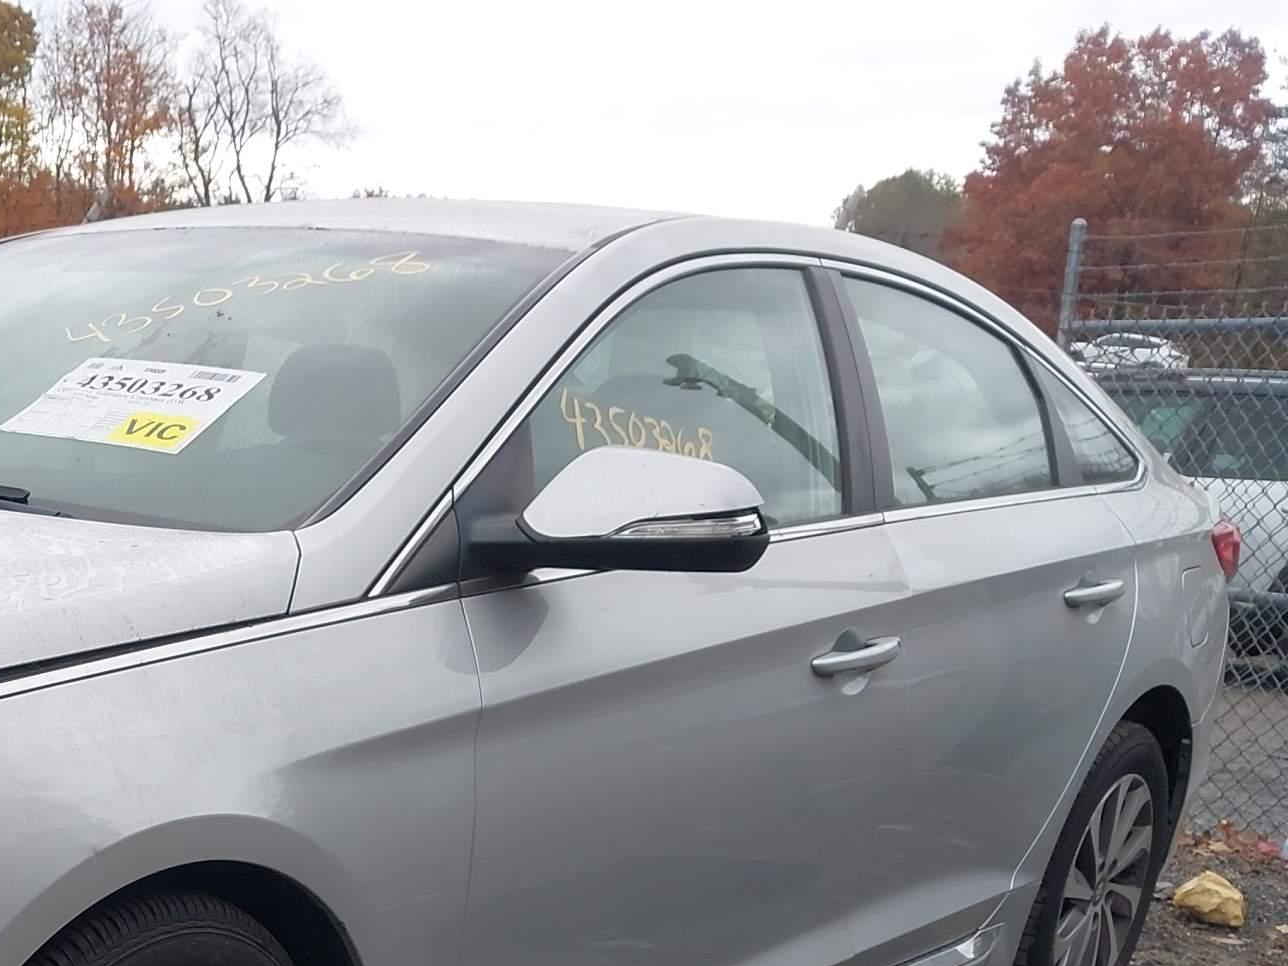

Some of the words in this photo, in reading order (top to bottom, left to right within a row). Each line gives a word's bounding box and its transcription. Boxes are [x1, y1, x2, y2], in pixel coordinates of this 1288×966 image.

[66, 251, 430, 343] 43503268
[77, 373, 222, 402] 43503268
[125, 418, 187, 441] VIC
